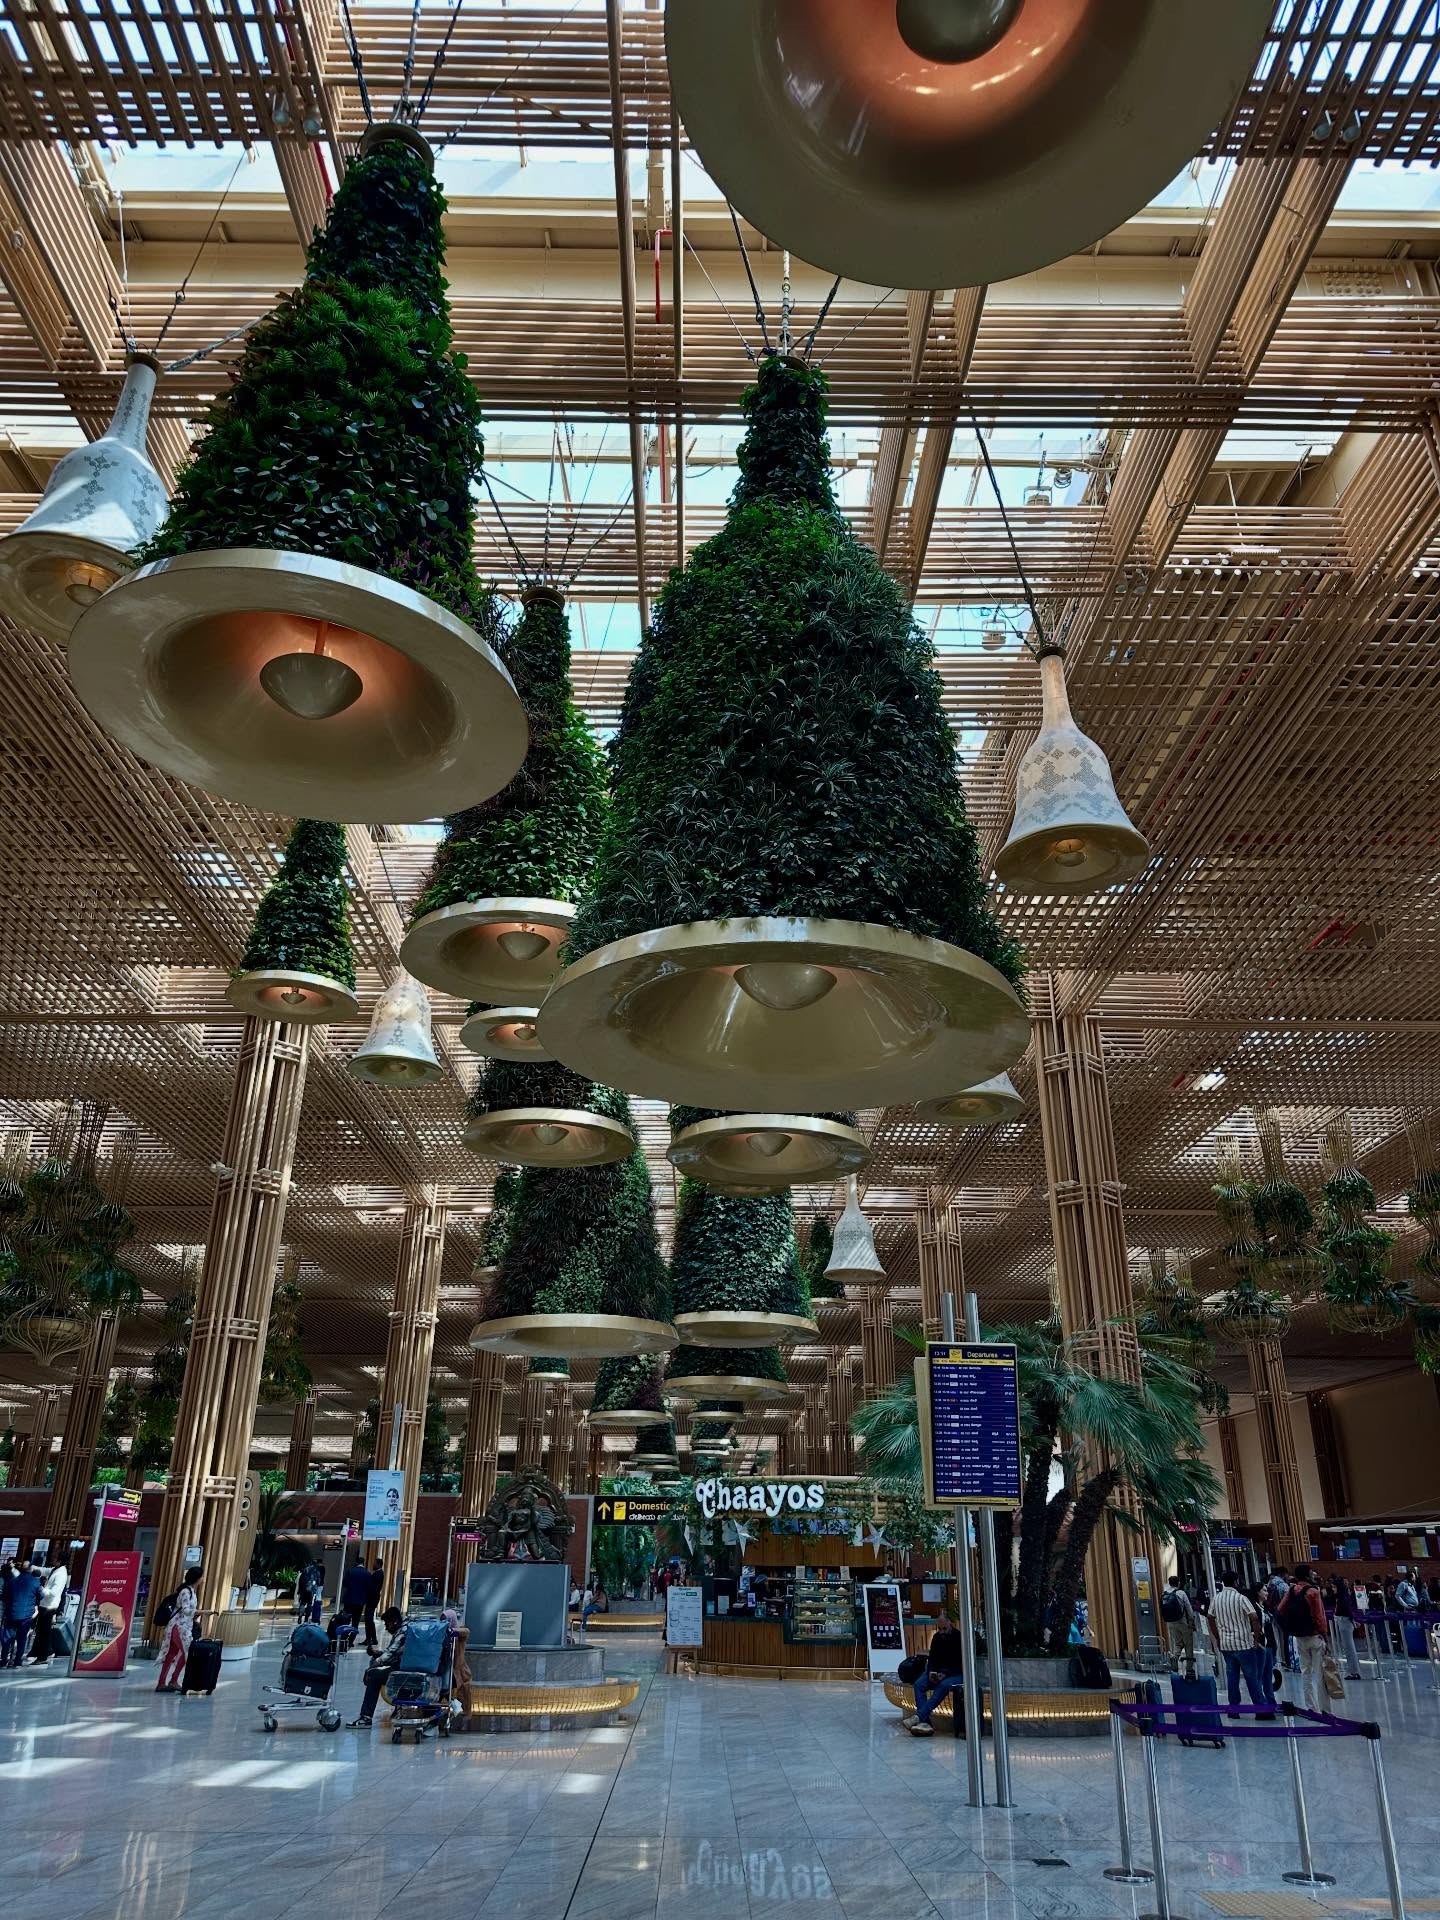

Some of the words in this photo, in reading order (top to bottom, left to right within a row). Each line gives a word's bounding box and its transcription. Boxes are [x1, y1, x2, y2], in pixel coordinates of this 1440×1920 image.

[967, 1351, 998, 1359] Departures
[695, 1477, 824, 1519] Chaayos
[629, 1501, 671, 1511] Domestic
